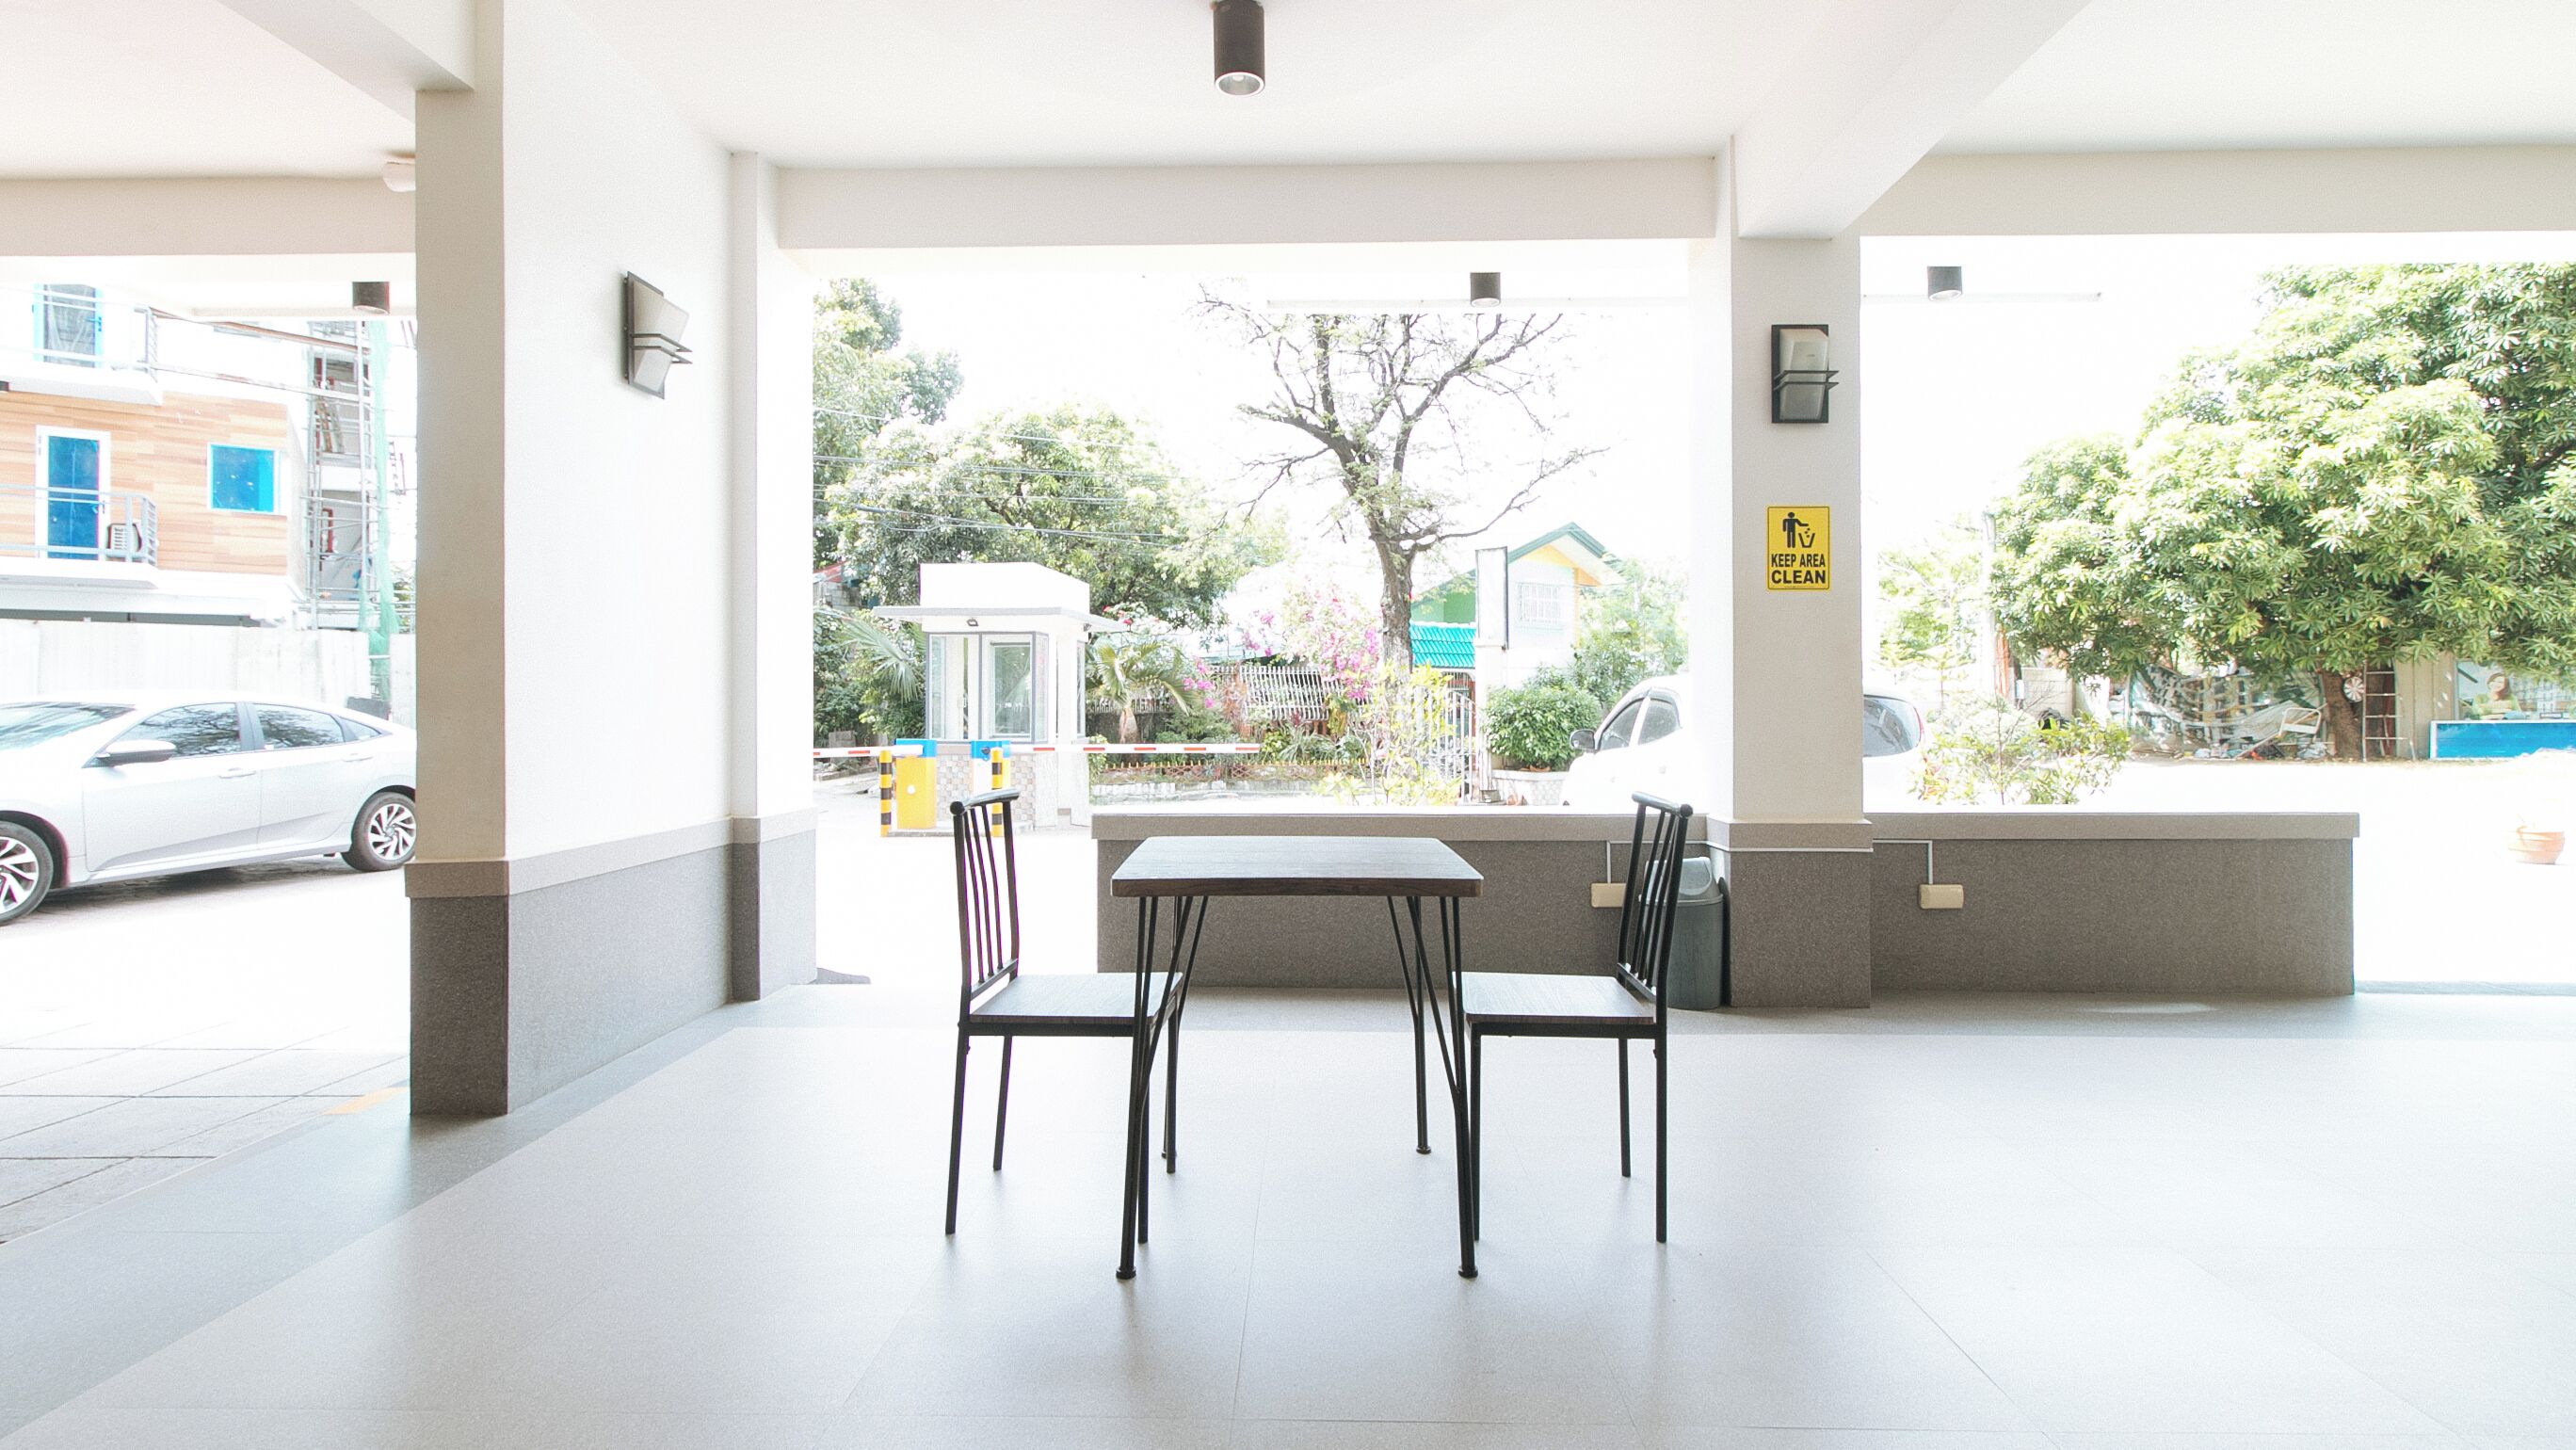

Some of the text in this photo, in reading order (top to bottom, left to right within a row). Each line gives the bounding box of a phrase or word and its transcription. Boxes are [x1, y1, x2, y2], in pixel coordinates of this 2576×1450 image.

[1771, 554, 1826, 568] KEEP AREA
[1771, 570, 1826, 584] CLEAN
